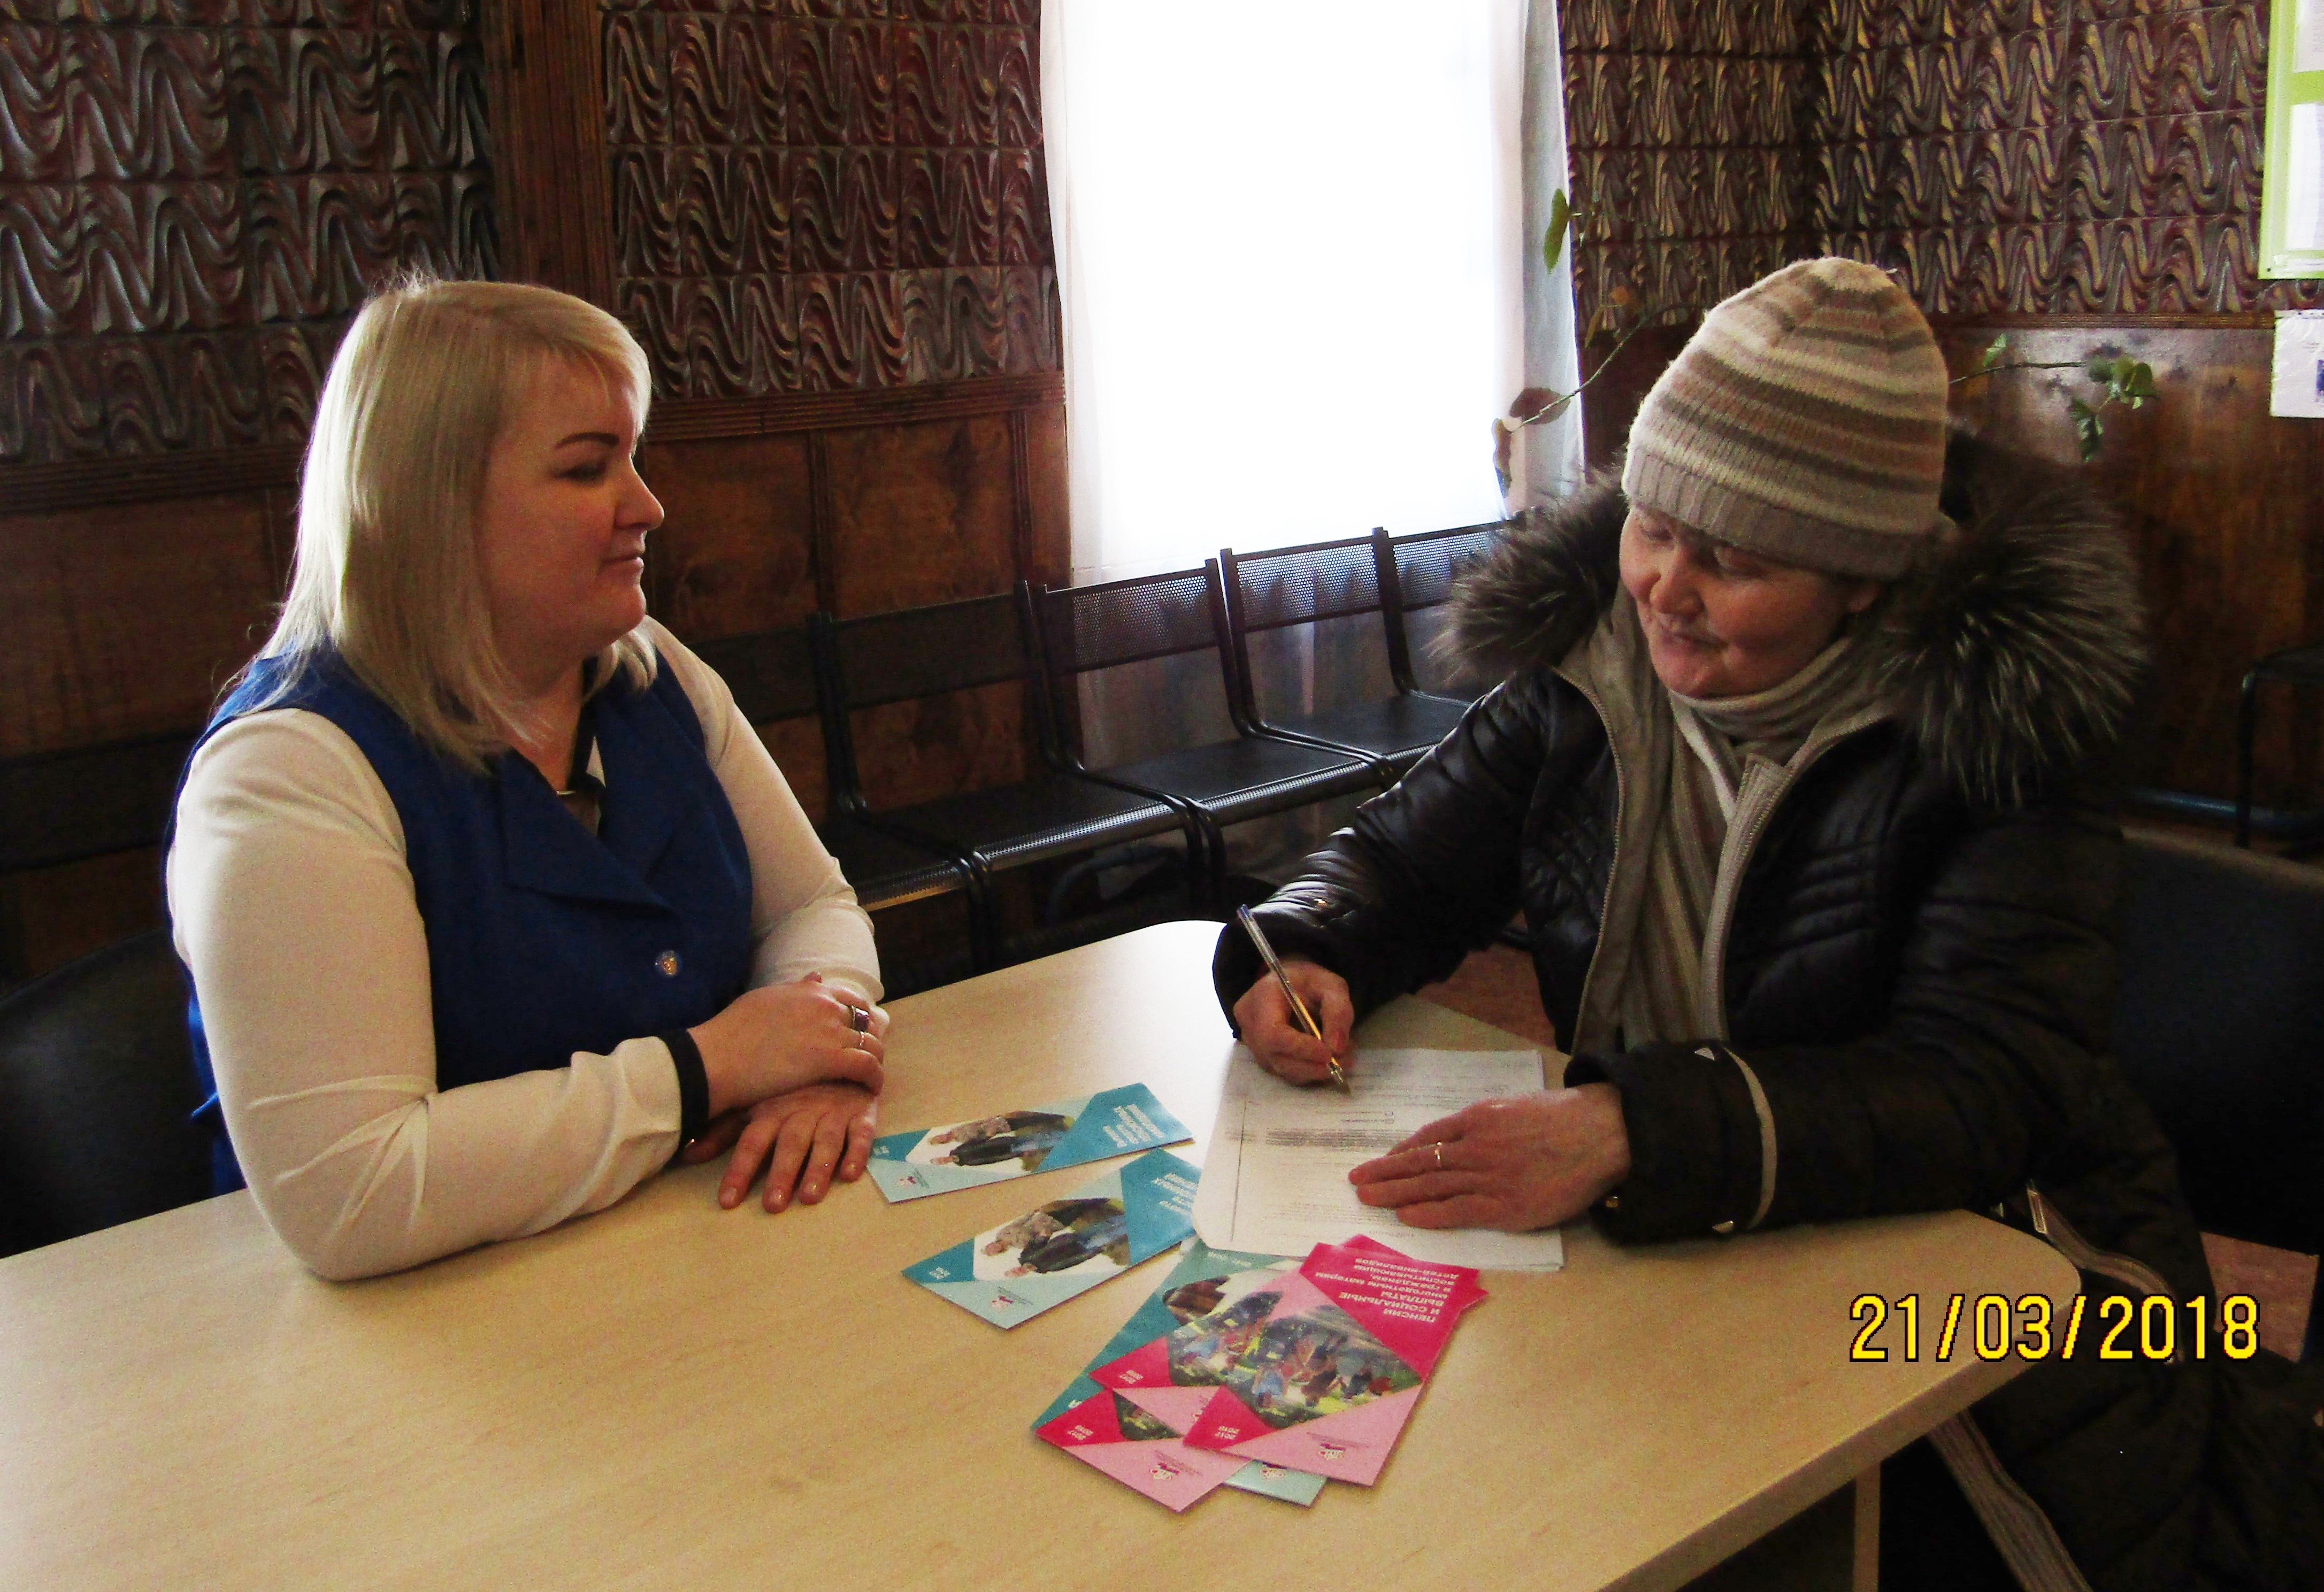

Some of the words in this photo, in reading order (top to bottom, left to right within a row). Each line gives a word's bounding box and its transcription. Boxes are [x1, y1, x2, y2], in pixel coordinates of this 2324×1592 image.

[1339, 1291, 1427, 1312] СОЦИАЛЬНЫЕ
[1380, 1291, 1444, 1306] ВЫПЛАТЫ
[1383, 1309, 1436, 1323] ПЕНСИИ
